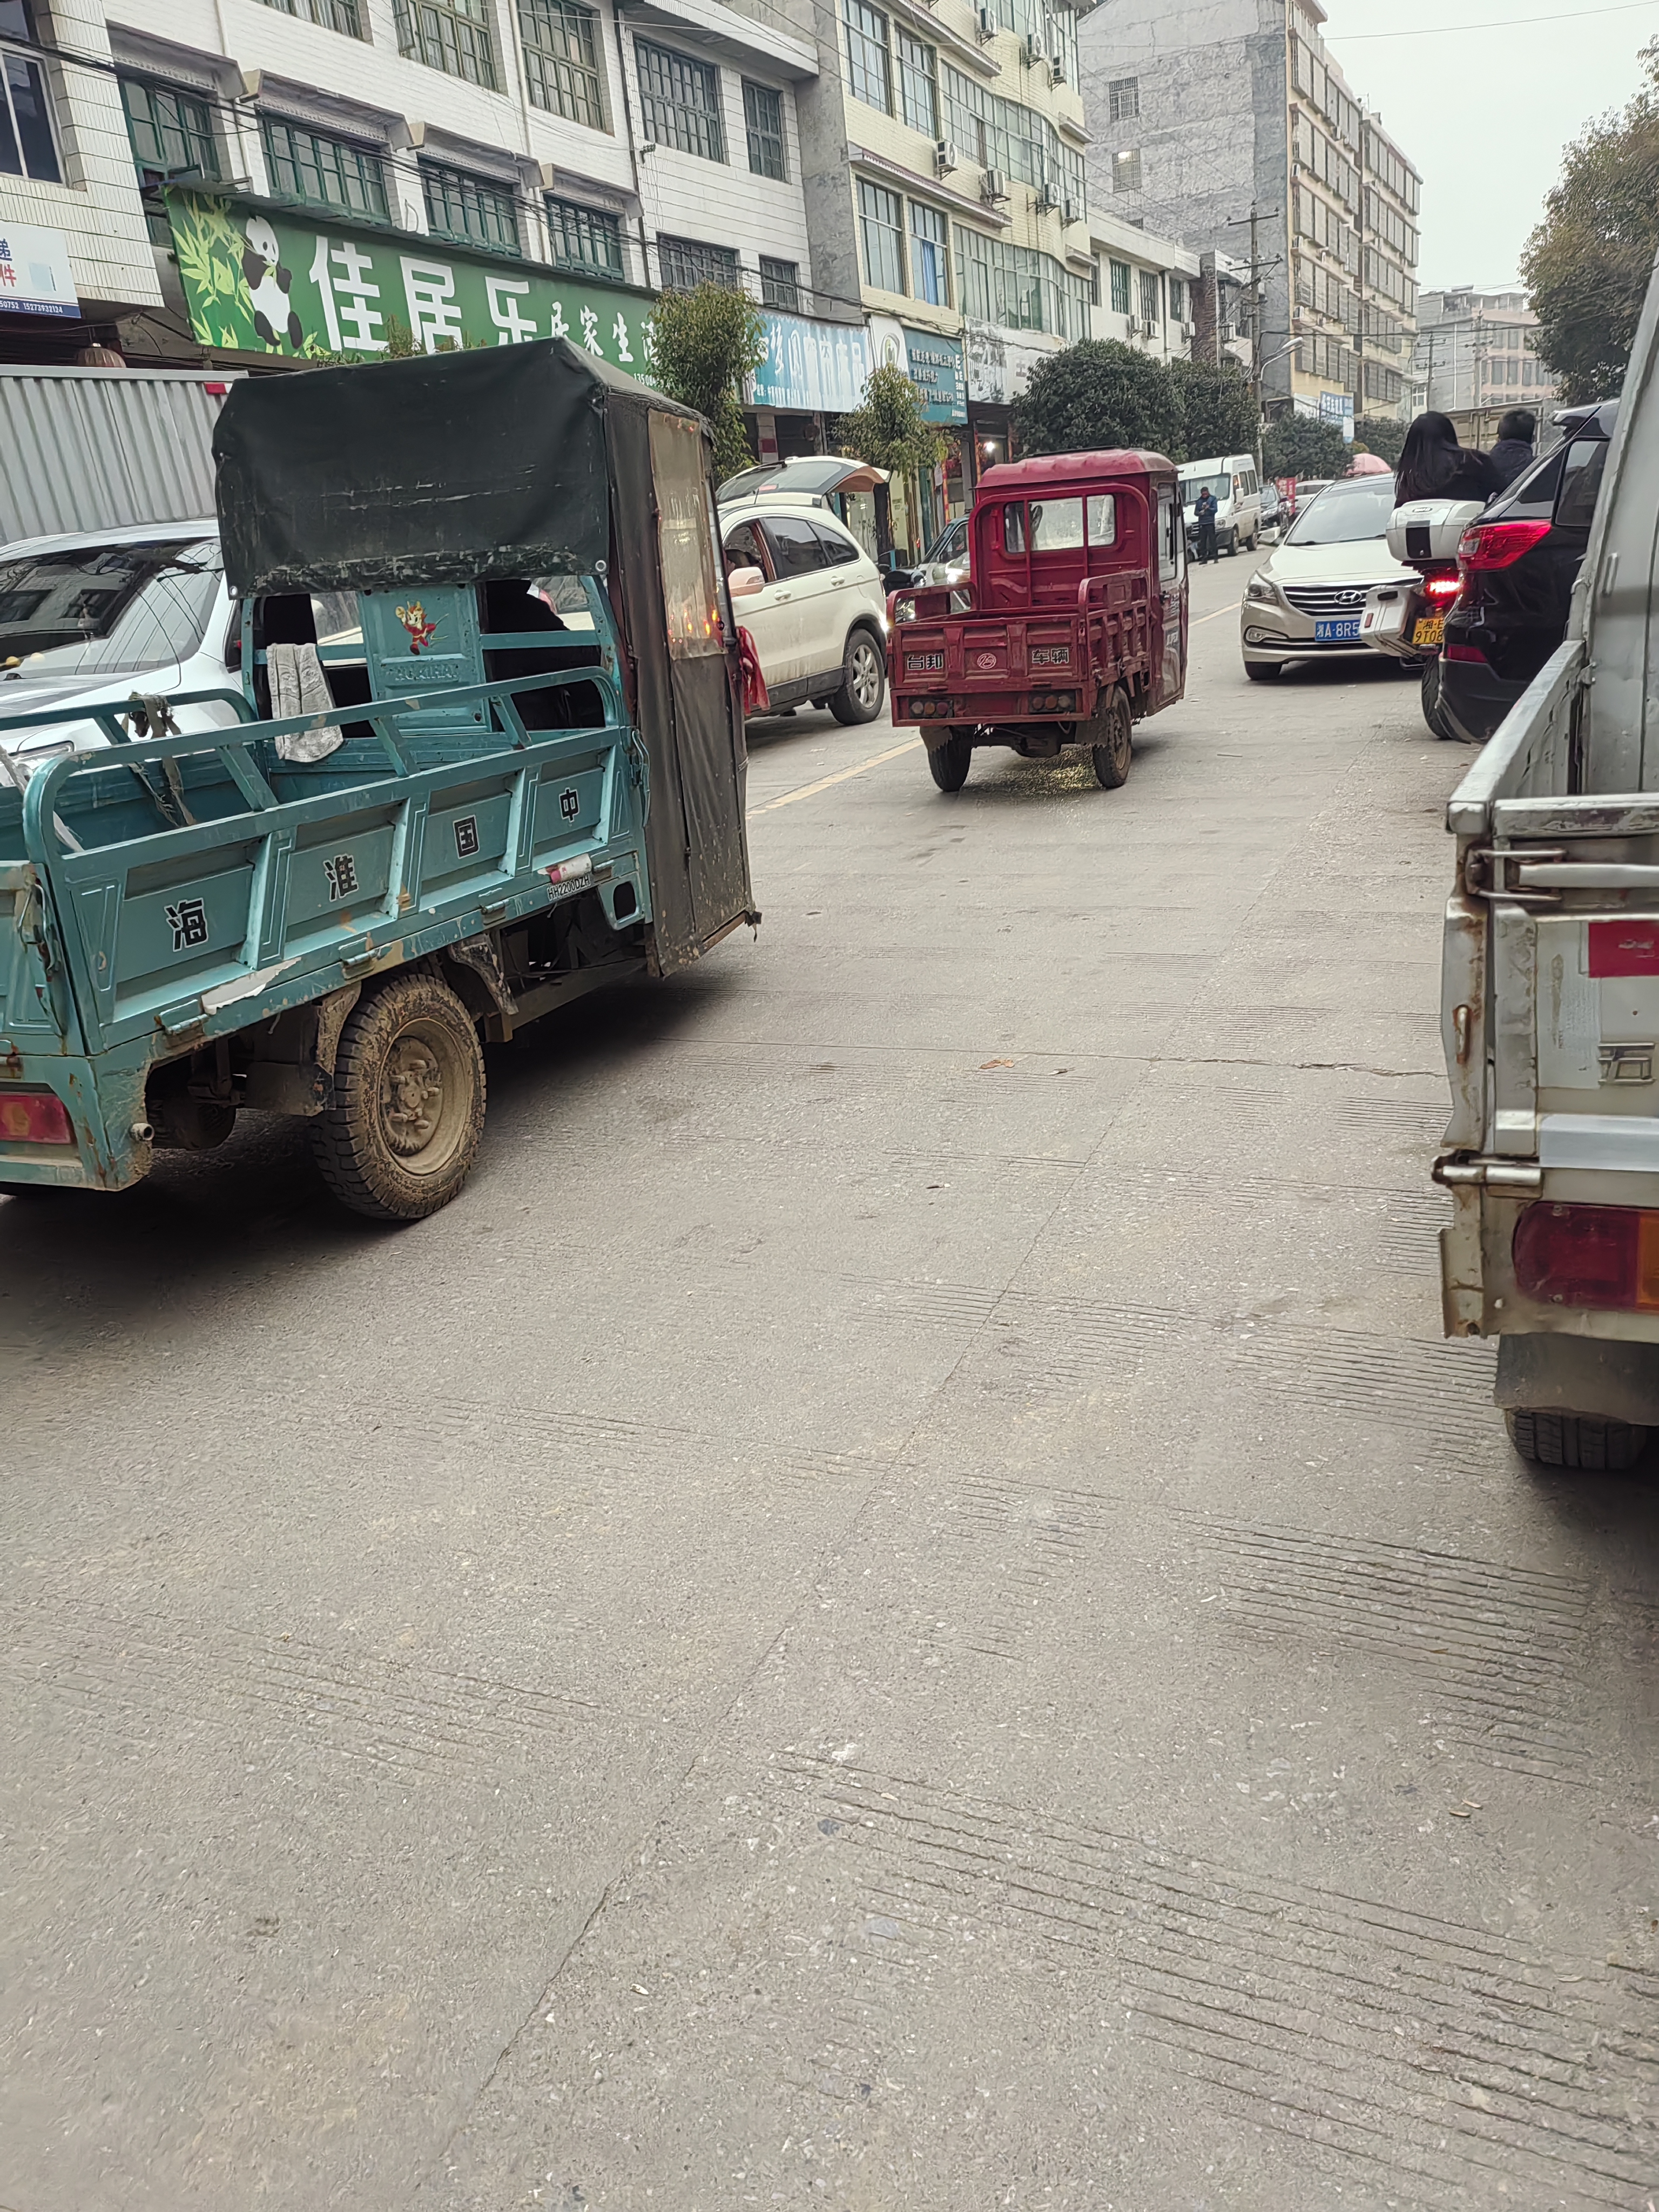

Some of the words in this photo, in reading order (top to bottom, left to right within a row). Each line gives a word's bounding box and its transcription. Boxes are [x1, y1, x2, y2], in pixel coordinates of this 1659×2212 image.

[309, 235, 537, 353] 佳居乐
[907, 653, 943, 670] 台邦
[1031, 648, 1069, 665] 车辆
